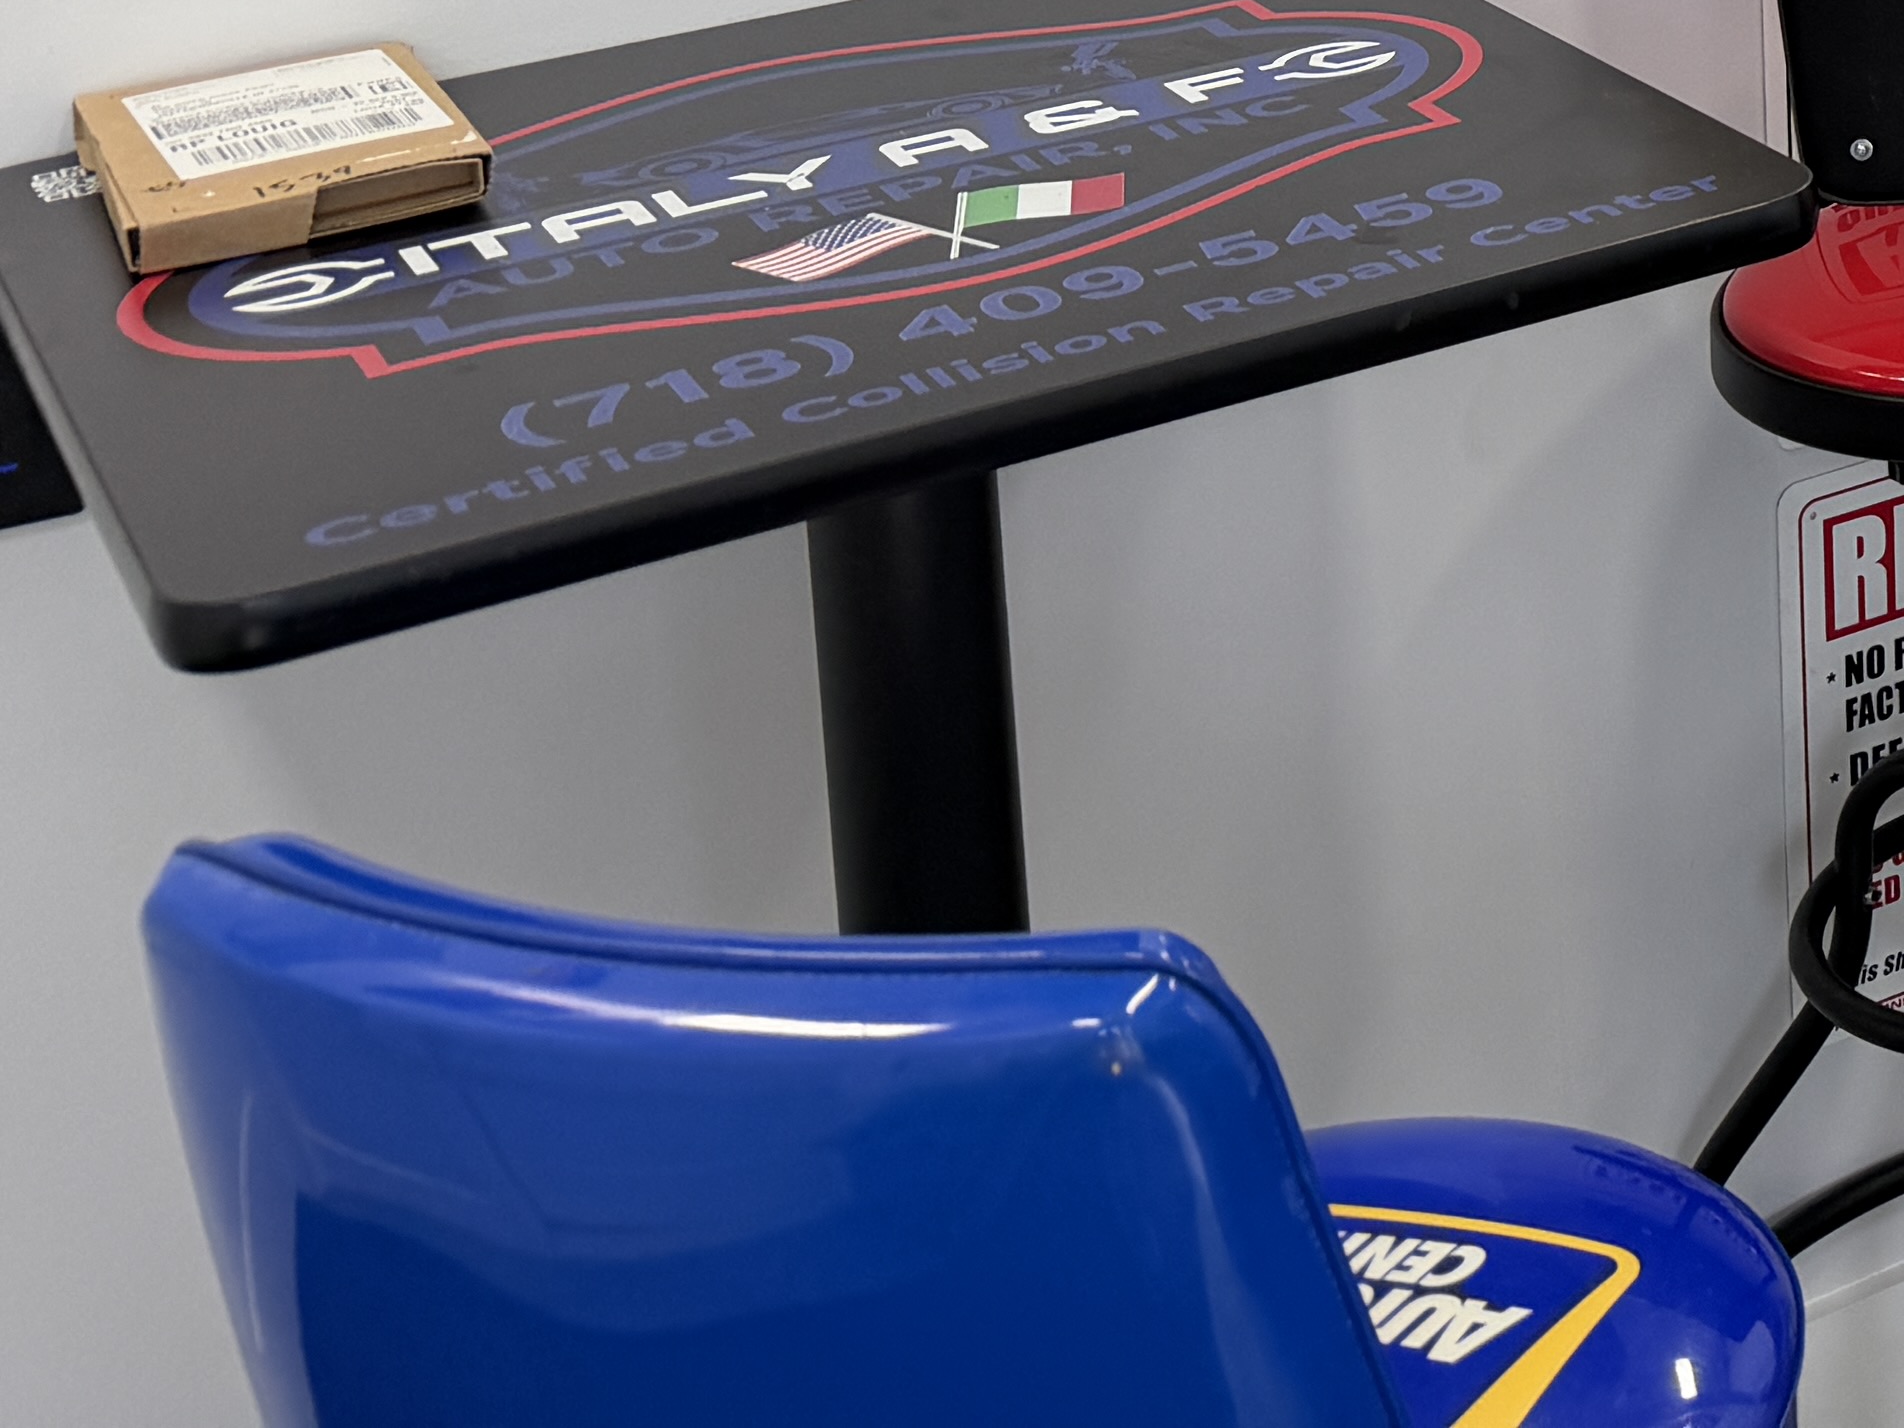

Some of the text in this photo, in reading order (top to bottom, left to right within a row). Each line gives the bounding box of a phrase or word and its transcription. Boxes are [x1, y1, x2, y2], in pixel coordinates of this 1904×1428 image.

[399, 66, 1245, 277] ITALY A & F
[305, 170, 1721, 547] Certified Collision Repair Center
[500, 176, 1505, 449] (718) 409-5459
